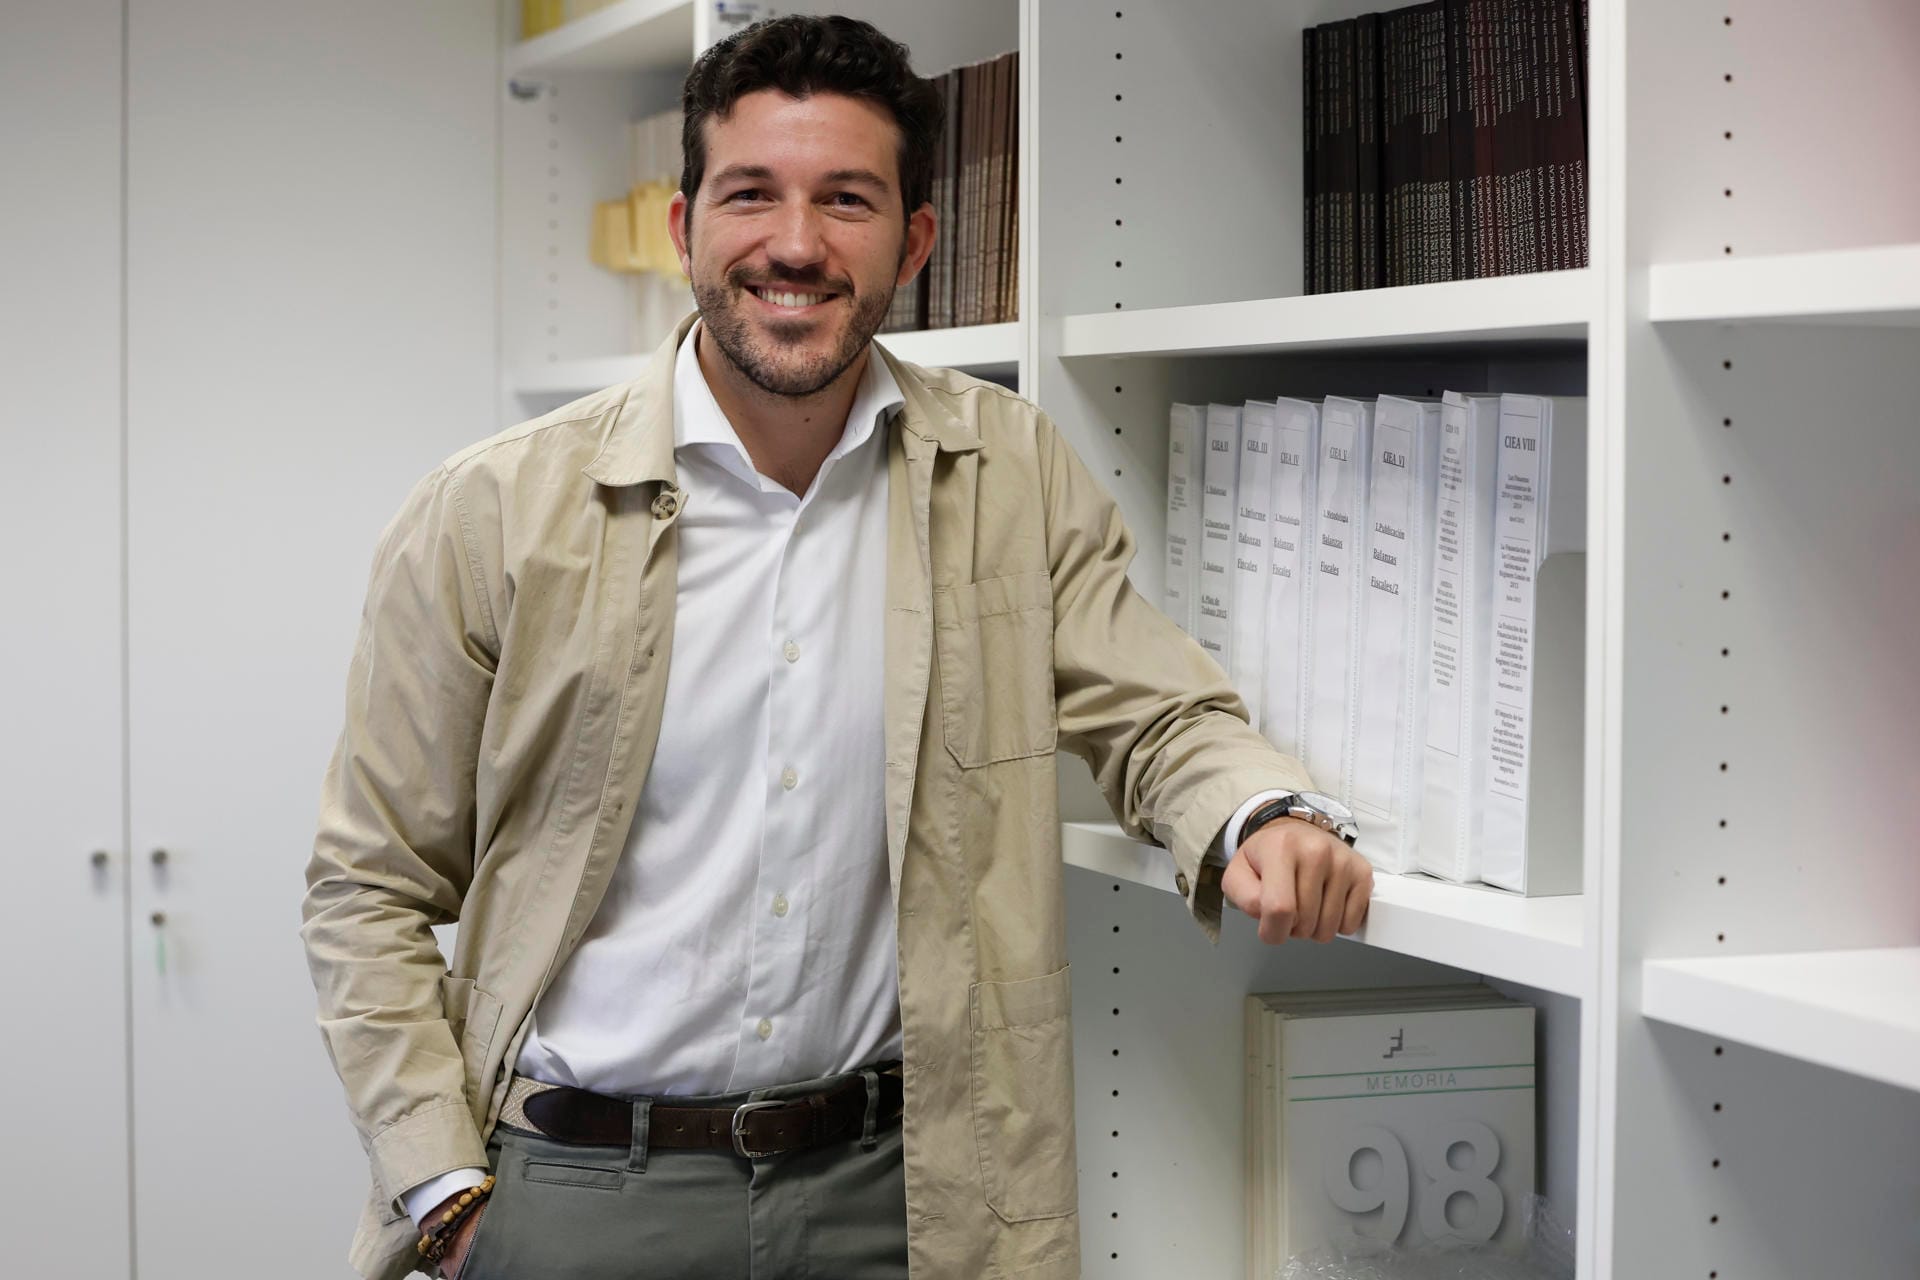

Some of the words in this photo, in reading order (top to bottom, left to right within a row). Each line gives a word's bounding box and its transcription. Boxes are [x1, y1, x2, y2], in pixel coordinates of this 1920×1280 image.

[1505, 435, 1520, 450] CIEA
[1522, 438, 1536, 452] VIII
[1383, 451, 1396, 466] CIEA
[1238, 532, 1261, 547] Balanzas
[1322, 533, 1343, 550] Balanzas
[1373, 548, 1397, 566] Balanzas
[1272, 564, 1291, 578] Fiscales
[1320, 561, 1339, 576] Fiscales
[1371, 576, 1399, 595] Fiscales/2
[1367, 1072, 1457, 1090] MEMORIA
[1323, 1118, 1505, 1246] 98
